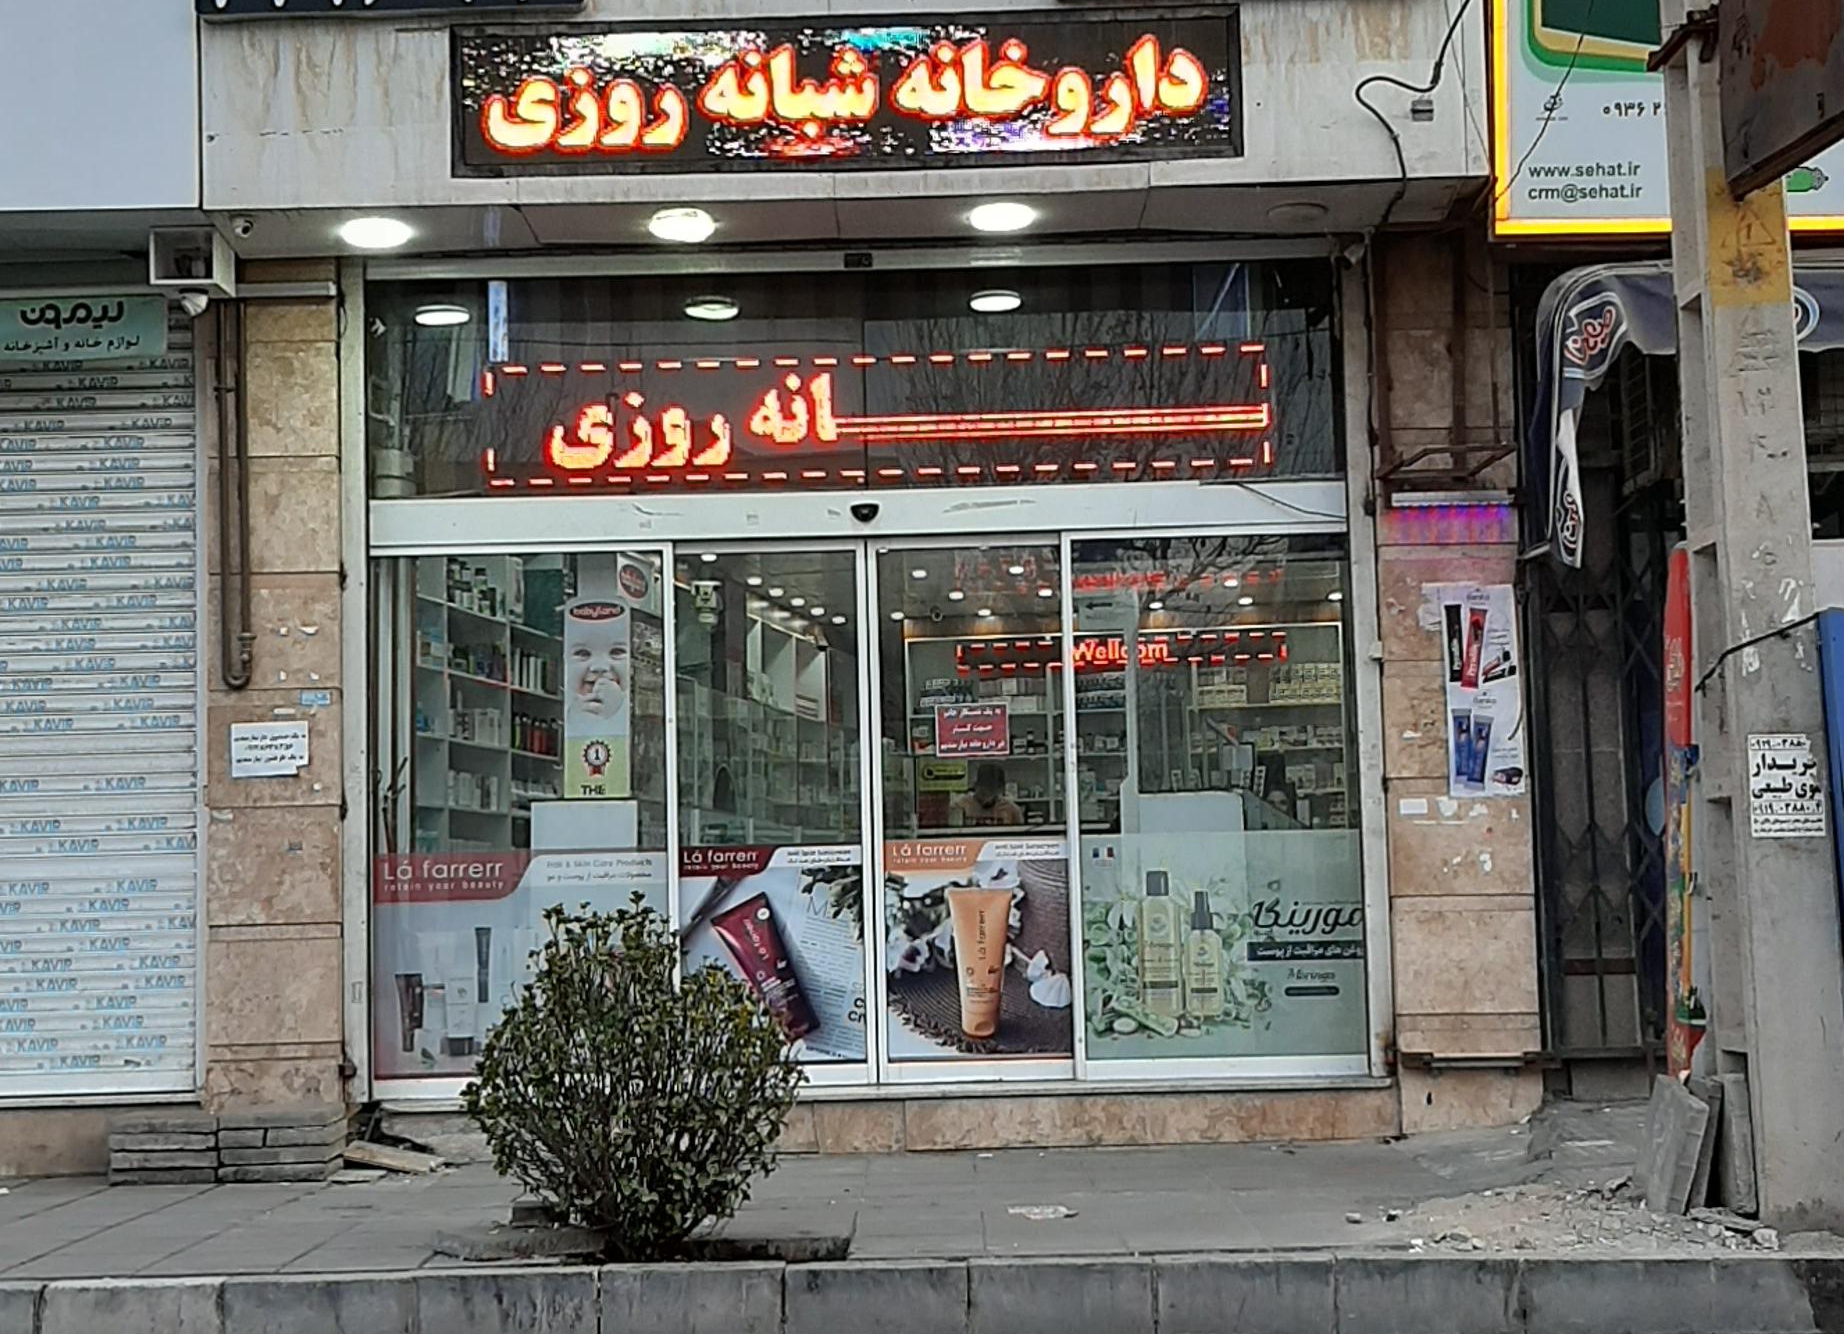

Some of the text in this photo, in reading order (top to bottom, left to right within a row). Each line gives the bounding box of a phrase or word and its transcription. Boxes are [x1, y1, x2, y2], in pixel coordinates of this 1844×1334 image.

[480, 33, 1208, 155] داروخانه شبانه روزی
[1529, 162, 1641, 179] www.sehat.ir
[1529, 184, 1643, 202] crm@sehat.ir
[20, 300, 124, 328] لیمون
[75, 338, 102, 349] خانه
[107, 335, 140, 352] لوازم
[546, 391, 733, 470] روزی
[384, 859, 504, 881] Lá farrerr
